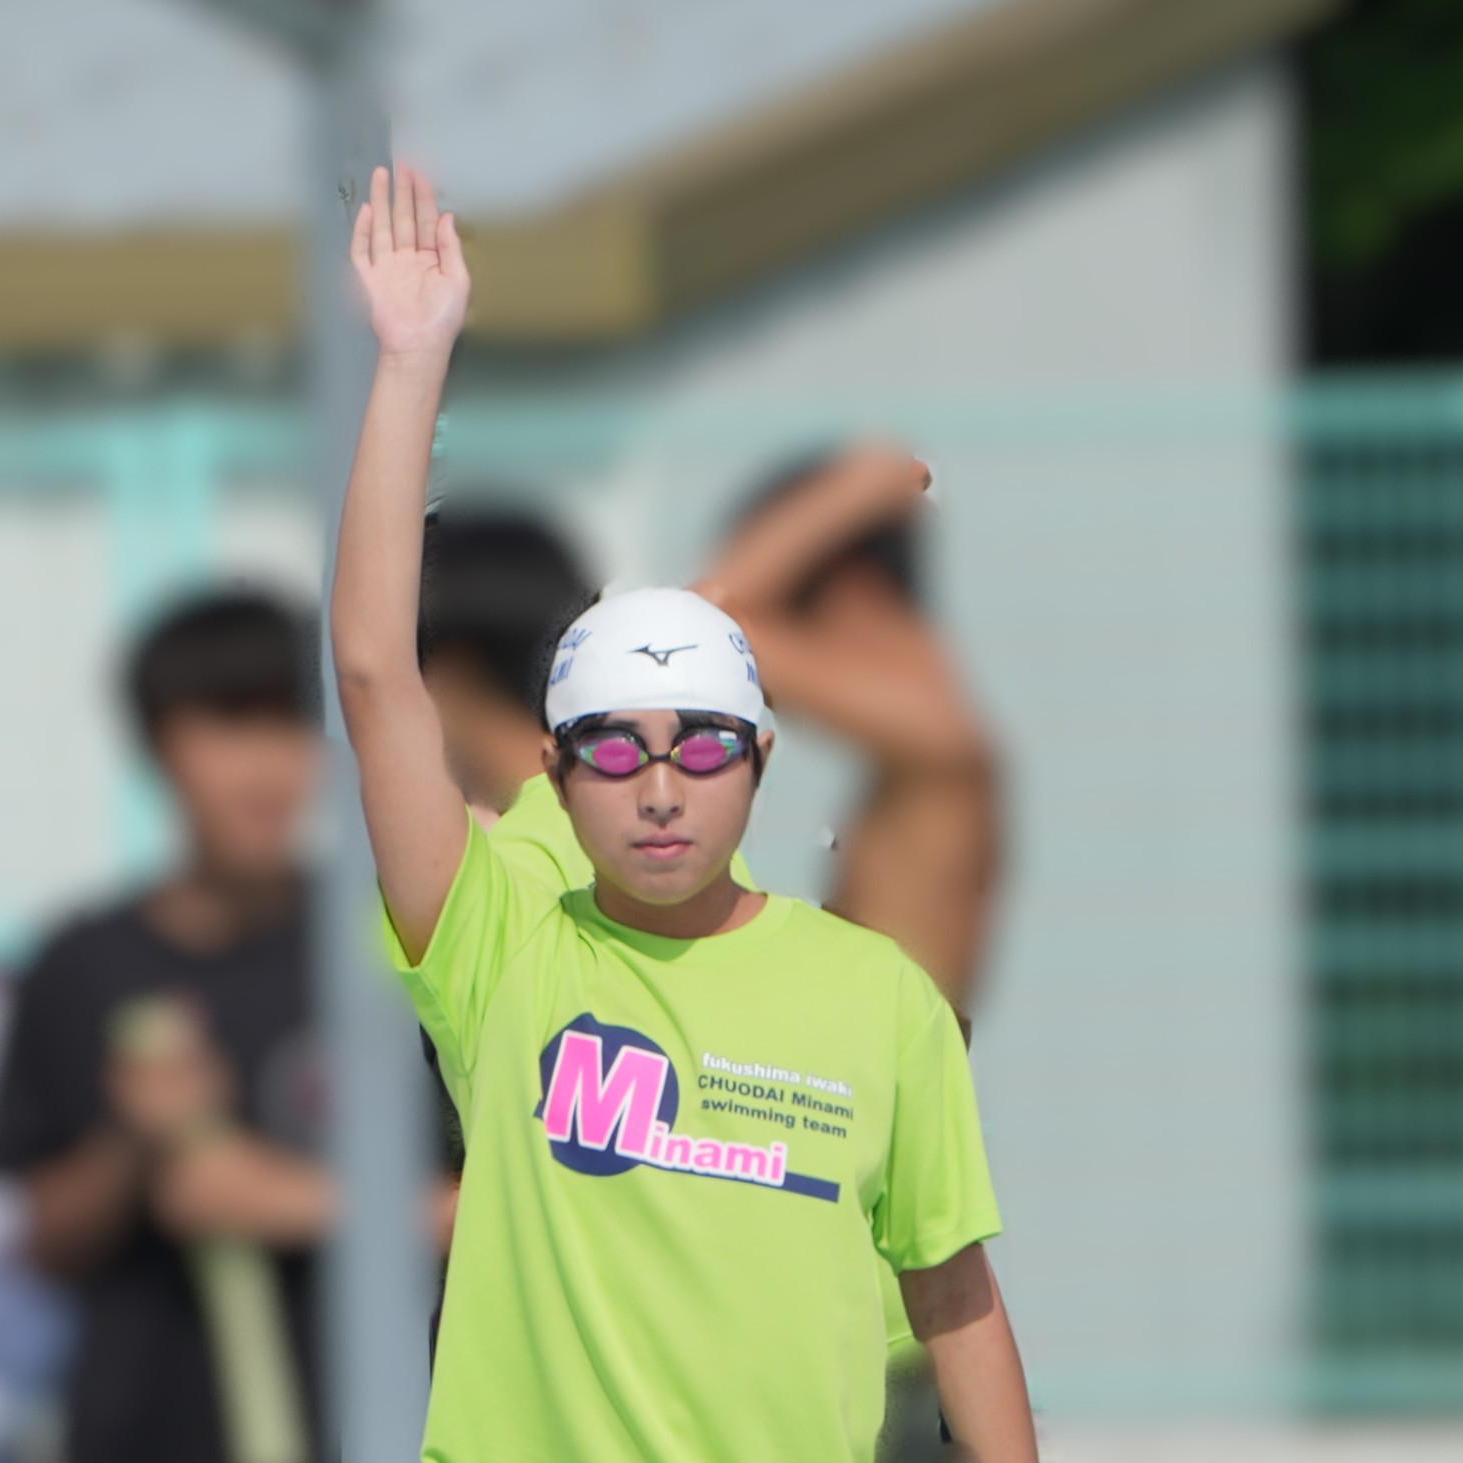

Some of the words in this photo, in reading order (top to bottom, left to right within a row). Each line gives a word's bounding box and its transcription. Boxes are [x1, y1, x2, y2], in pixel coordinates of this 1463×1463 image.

[702, 1052, 801, 1084] fukushima
[544, 1031, 786, 1185] Minami
[697, 1074, 785, 1103] CHUODAI
[791, 1090, 854, 1121] Minami
[701, 1098, 796, 1130] swimming
[803, 1115, 847, 1139] team
